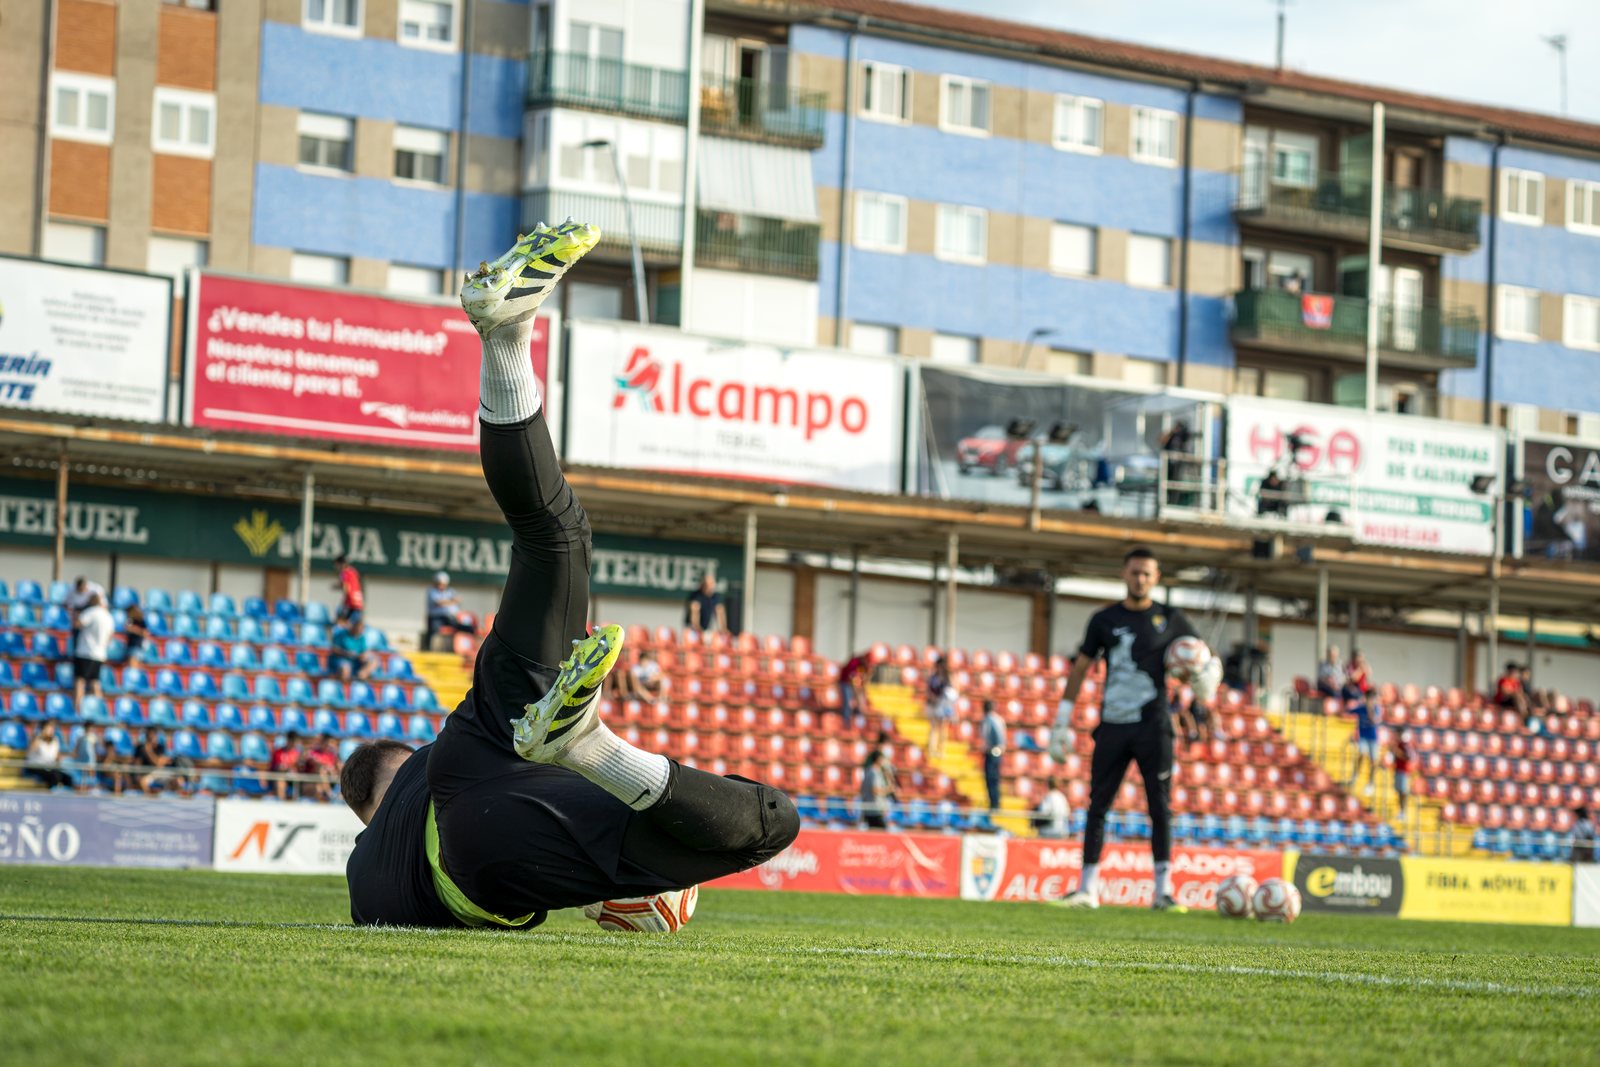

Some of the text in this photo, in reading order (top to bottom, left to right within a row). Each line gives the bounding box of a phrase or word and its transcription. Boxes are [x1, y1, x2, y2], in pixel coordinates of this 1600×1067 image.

[306, 317, 332, 342] tu
[332, 317, 448, 356] inmueble?
[206, 337, 380, 378] Nosotros tenemos
[206, 361, 226, 382] el
[227, 362, 294, 390] cliente
[294, 373, 340, 397] para
[613, 346, 868, 440] Alcampo
[0, 495, 149, 544] TERUEL
[1306, 865, 1393, 899] embou
